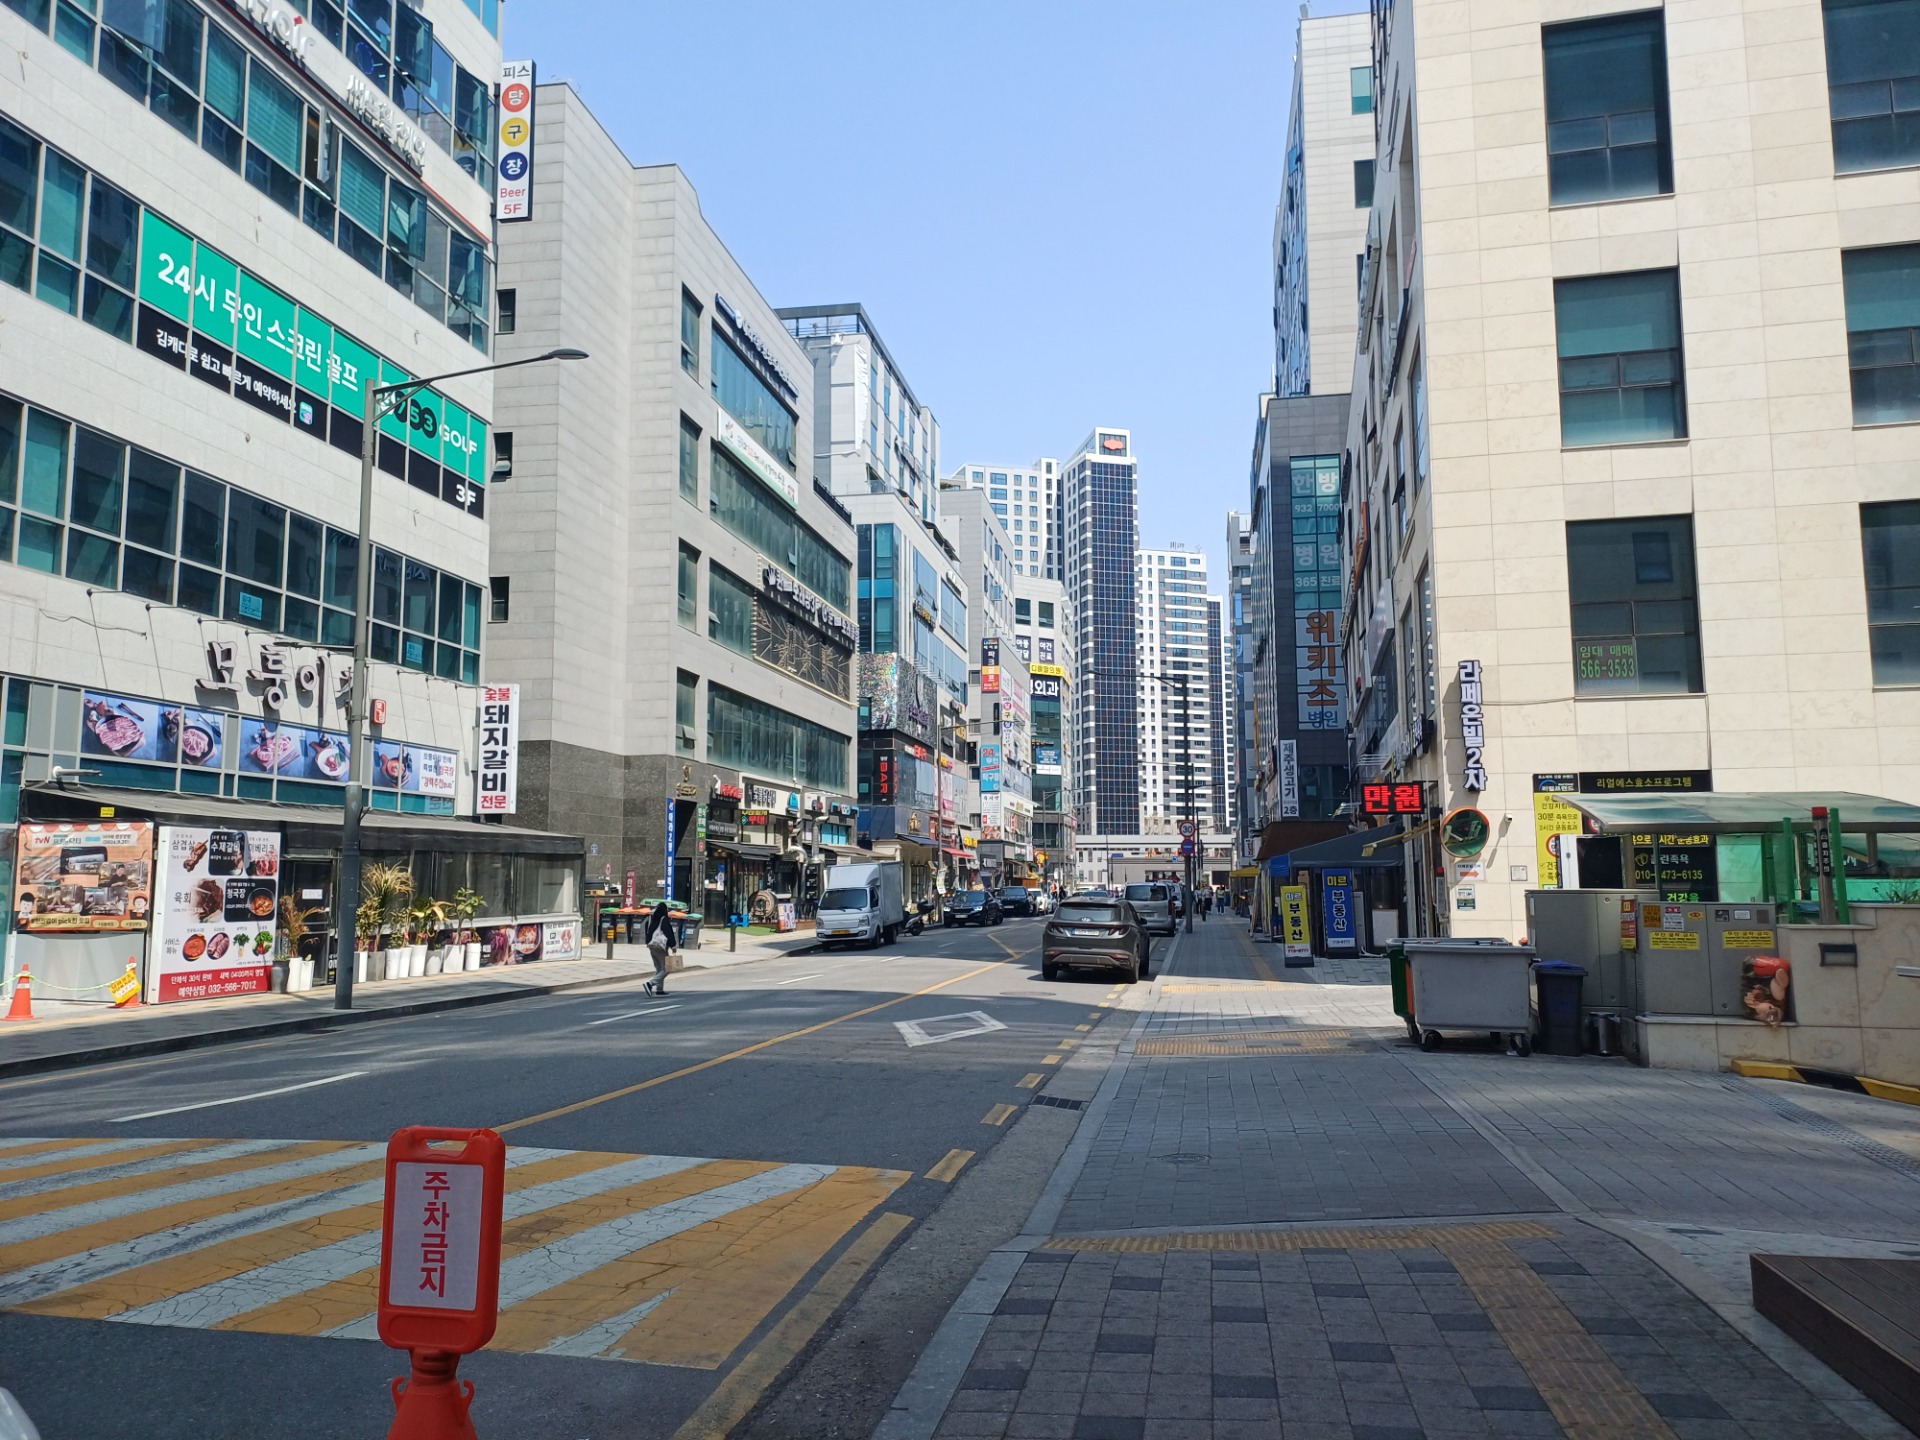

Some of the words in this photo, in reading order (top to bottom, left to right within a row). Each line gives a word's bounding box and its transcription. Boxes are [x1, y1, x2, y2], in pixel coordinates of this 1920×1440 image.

[502, 65, 531, 79] 피스
[506, 89, 524, 176] 당구장
[500, 186, 526, 198] Beer
[503, 203, 523, 216] 5F
[158, 253, 216, 312] 24시
[222, 289, 263, 340] 무인
[266, 320, 322, 373] 스크린
[326, 350, 359, 392] 골프
[201, 351, 221, 374] 쉽고
[253, 381, 297, 414] 예약하세요
[439, 423, 478, 455] GOLF
[455, 484, 477, 506] 3F
[1294, 504, 1313, 513] 932
[1295, 545, 1339, 566] 병원
[1295, 577, 1317, 588] 365
[1306, 611, 1338, 706] 위키즈
[1580, 646, 1603, 658] 임대
[1610, 645, 1633, 656] 매매
[1581, 658, 1635, 678] 566-3533
[484, 687, 511, 702] 숯불
[1308, 711, 1338, 729] 병원
[481, 704, 510, 793] 돼지갈비
[1283, 742, 1296, 799] 제주생고기
[480, 795, 507, 809] 전문
[1284, 805, 1298, 815] 2층
[1182, 825, 1193, 834] 30
[1326, 875, 1348, 886] 미르
[1635, 869, 1703, 880] 010-473-6135
[174, 891, 192, 904] 육회
[1285, 892, 1303, 901] 미르
[1331, 889, 1348, 932] 부동산
[1289, 902, 1304, 941] 부동산
[178, 984, 206, 997] 예약상담
[418, 1171, 451, 1298] 주차금지
